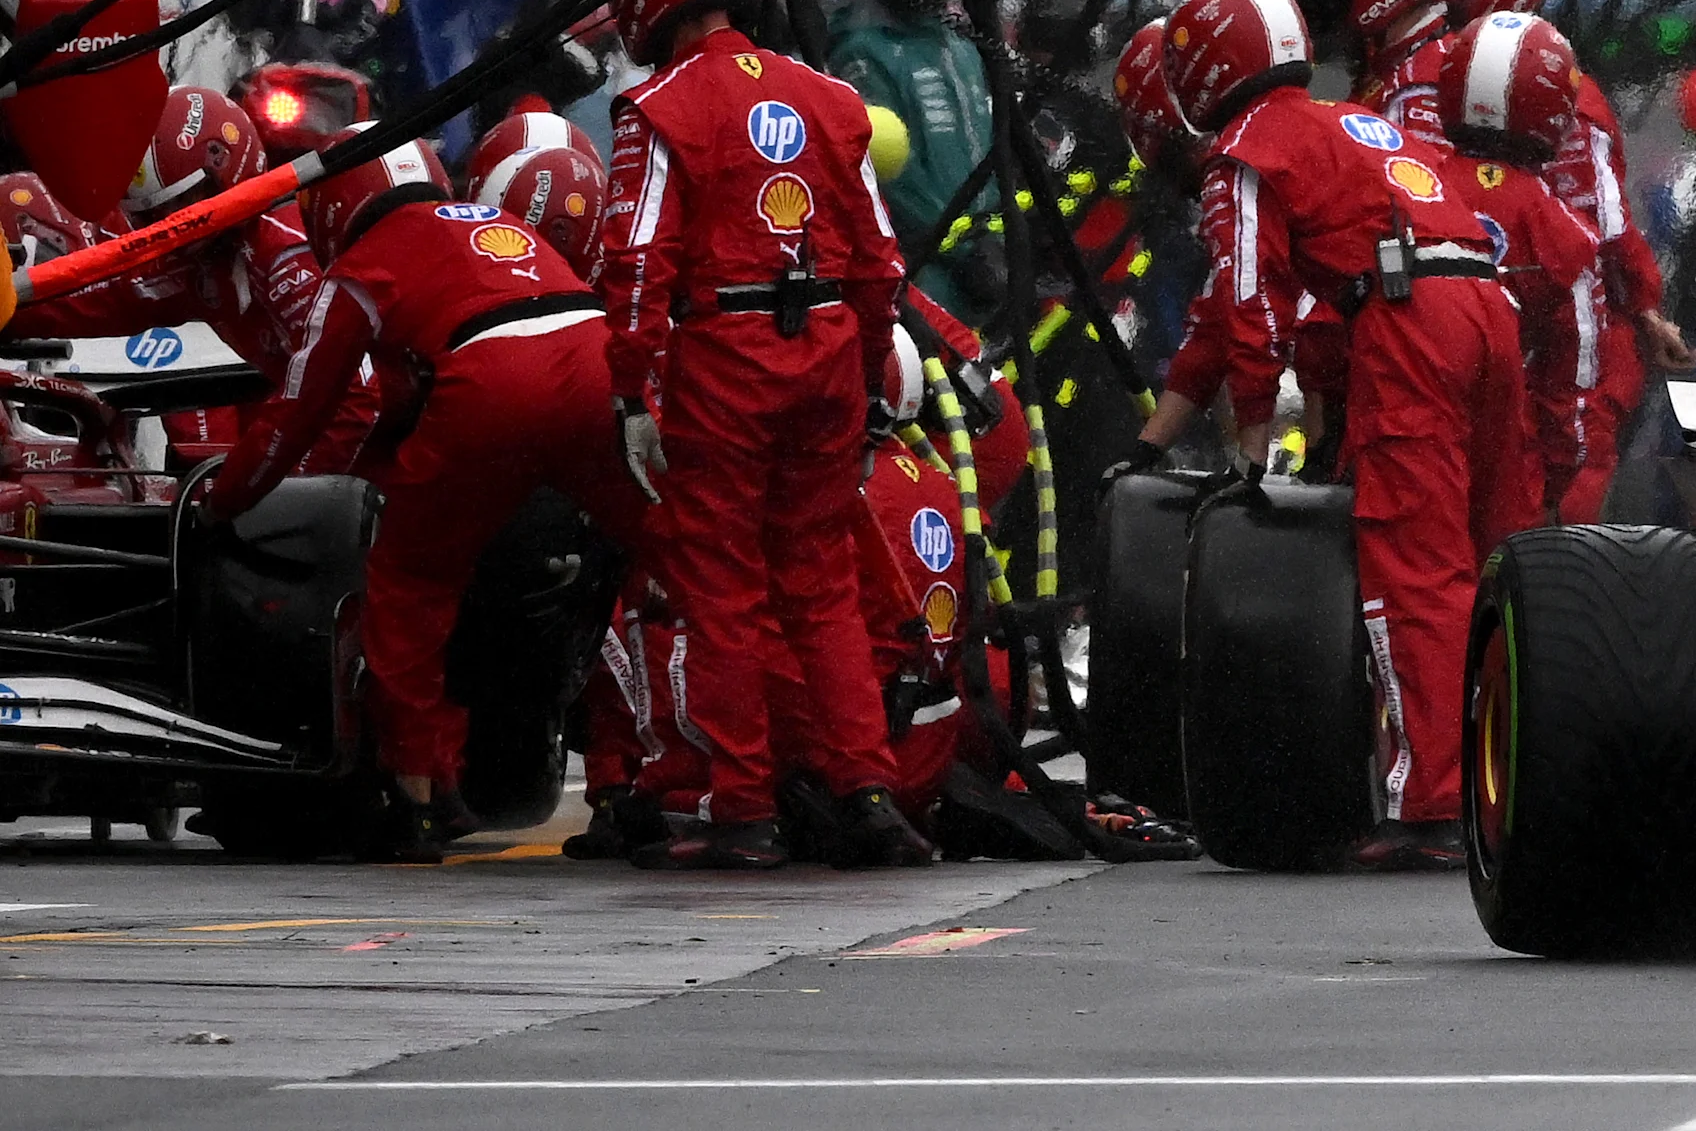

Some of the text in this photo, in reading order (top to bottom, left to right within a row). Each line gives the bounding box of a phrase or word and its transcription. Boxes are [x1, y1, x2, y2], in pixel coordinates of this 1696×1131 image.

[757, 101, 800, 162] hp
[1350, 114, 1396, 150] hp
[447, 204, 493, 221] hp
[526, 170, 550, 225] UniCredit
[129, 327, 179, 368] hp
[22, 448, 73, 469] Ray-Ban
[917, 508, 949, 572] hp
